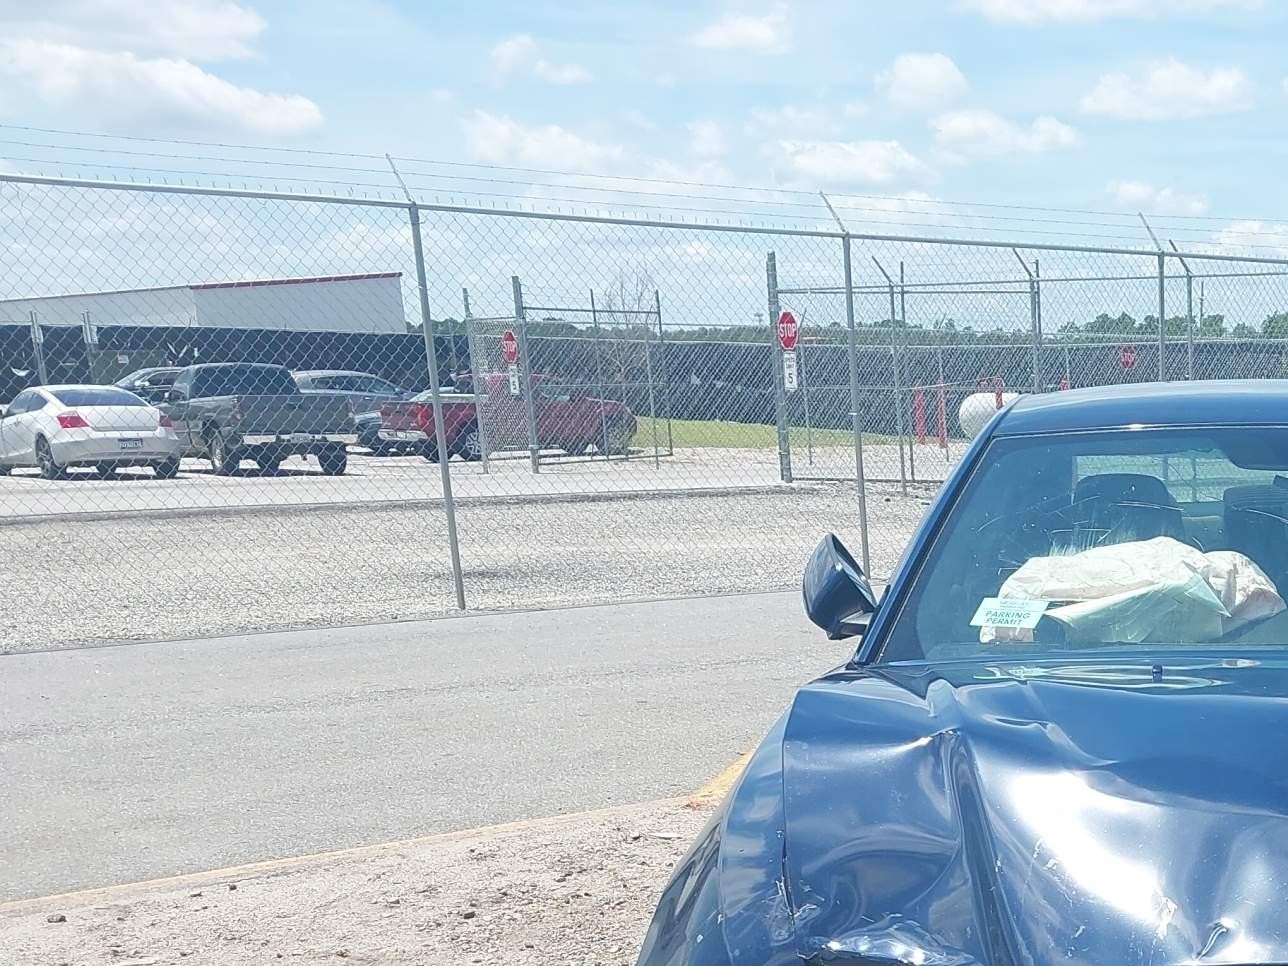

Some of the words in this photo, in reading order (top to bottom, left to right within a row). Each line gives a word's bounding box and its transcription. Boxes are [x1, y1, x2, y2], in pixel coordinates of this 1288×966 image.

[780, 323, 797, 338] STOP
[788, 372, 794, 384] 5
[985, 610, 1031, 619] PARKING
[985, 617, 1024, 625] PERMIT
